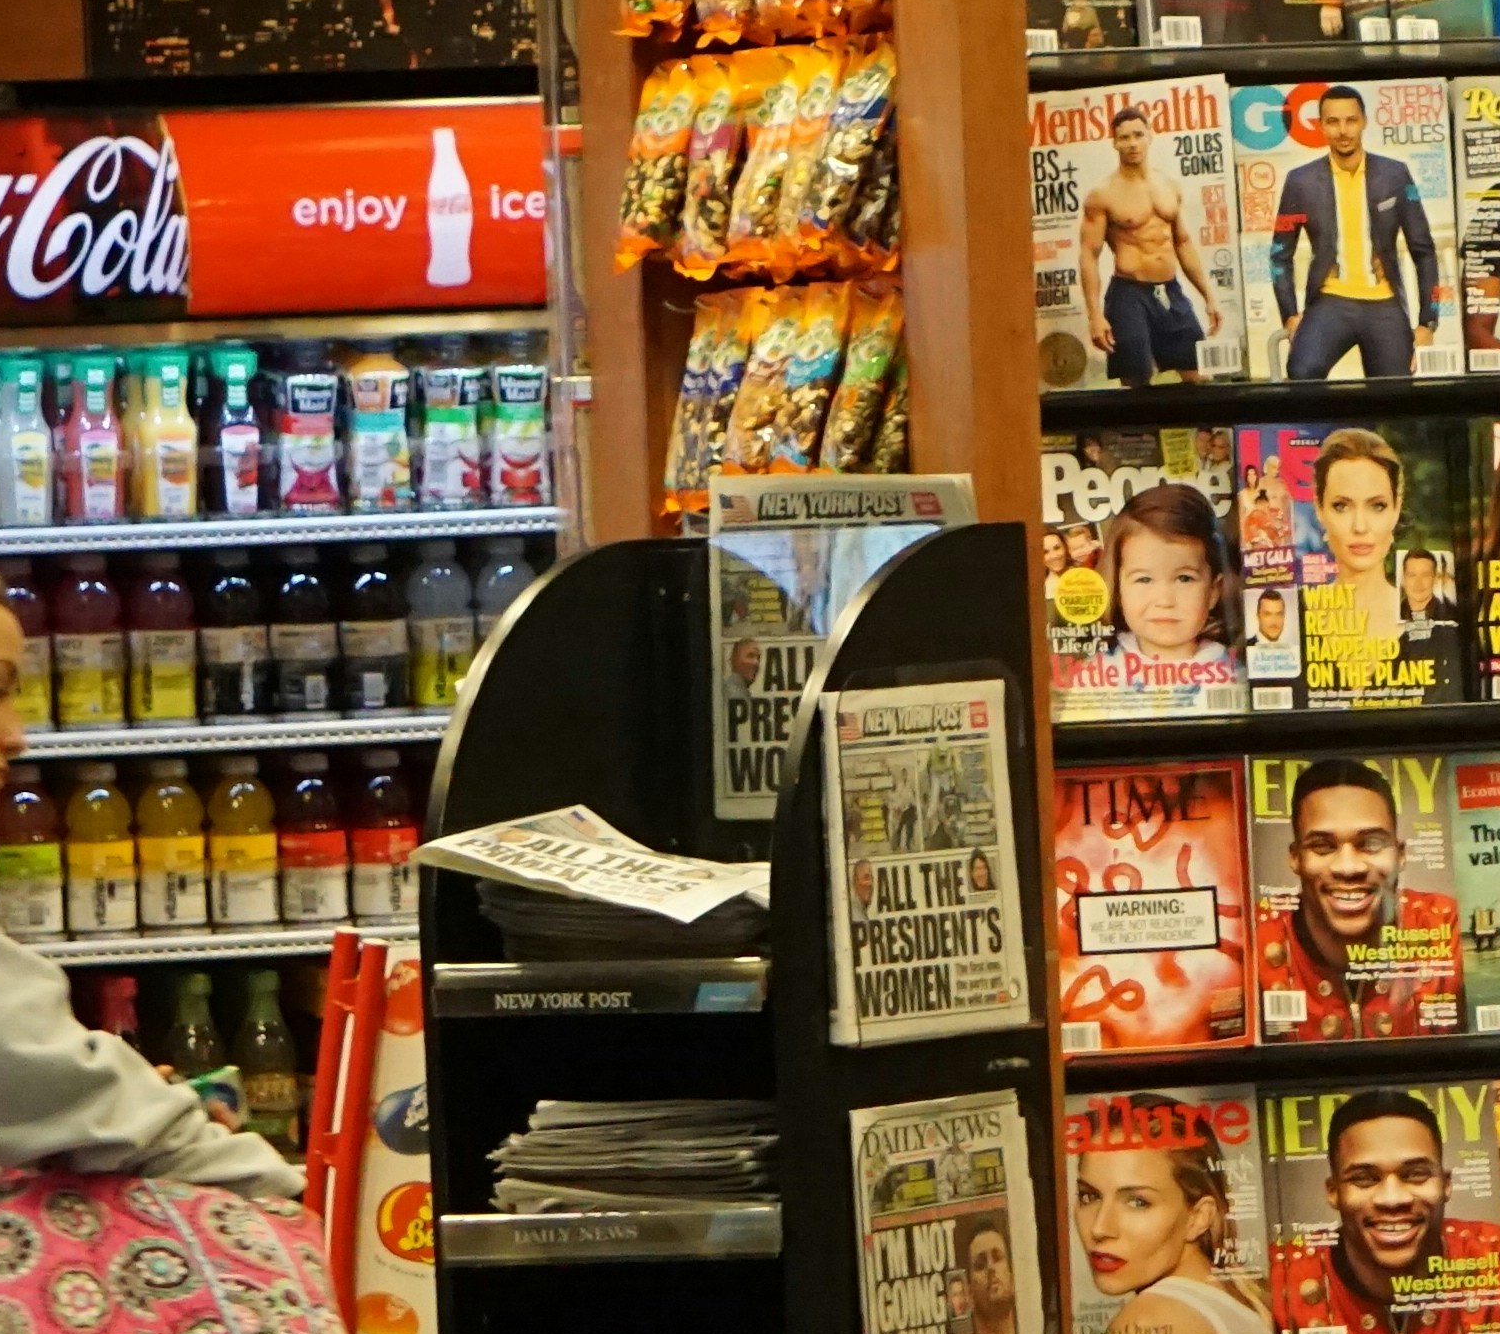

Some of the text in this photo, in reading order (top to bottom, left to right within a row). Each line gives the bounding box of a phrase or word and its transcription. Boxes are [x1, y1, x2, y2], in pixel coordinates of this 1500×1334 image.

[1377, 85, 1443, 107] STEPH
[1383, 124, 1445, 145] RULES
[292, 181, 547, 238] enjoy ice
[759, 490, 907, 518] NEW YORK POST
[1266, 548, 1295, 564] GALA
[1303, 585, 1358, 610] WHAT
[1070, 777, 1211, 827] TIME
[876, 861, 966, 914] ALL THE
[1105, 899, 1187, 918] WARNING:
[852, 907, 1002, 967] PRESIDENT'S
[1380, 925, 1452, 943] Russell
[1346, 942, 1452, 964] Westbrook
[494, 991, 632, 1010] NEW YORK POST
[855, 963, 951, 1018] WOMEN
[1063, 1094, 1251, 1154] allure
[513, 1224, 639, 1244] DAILY NEWS
[875, 1272, 947, 1333] GOING
